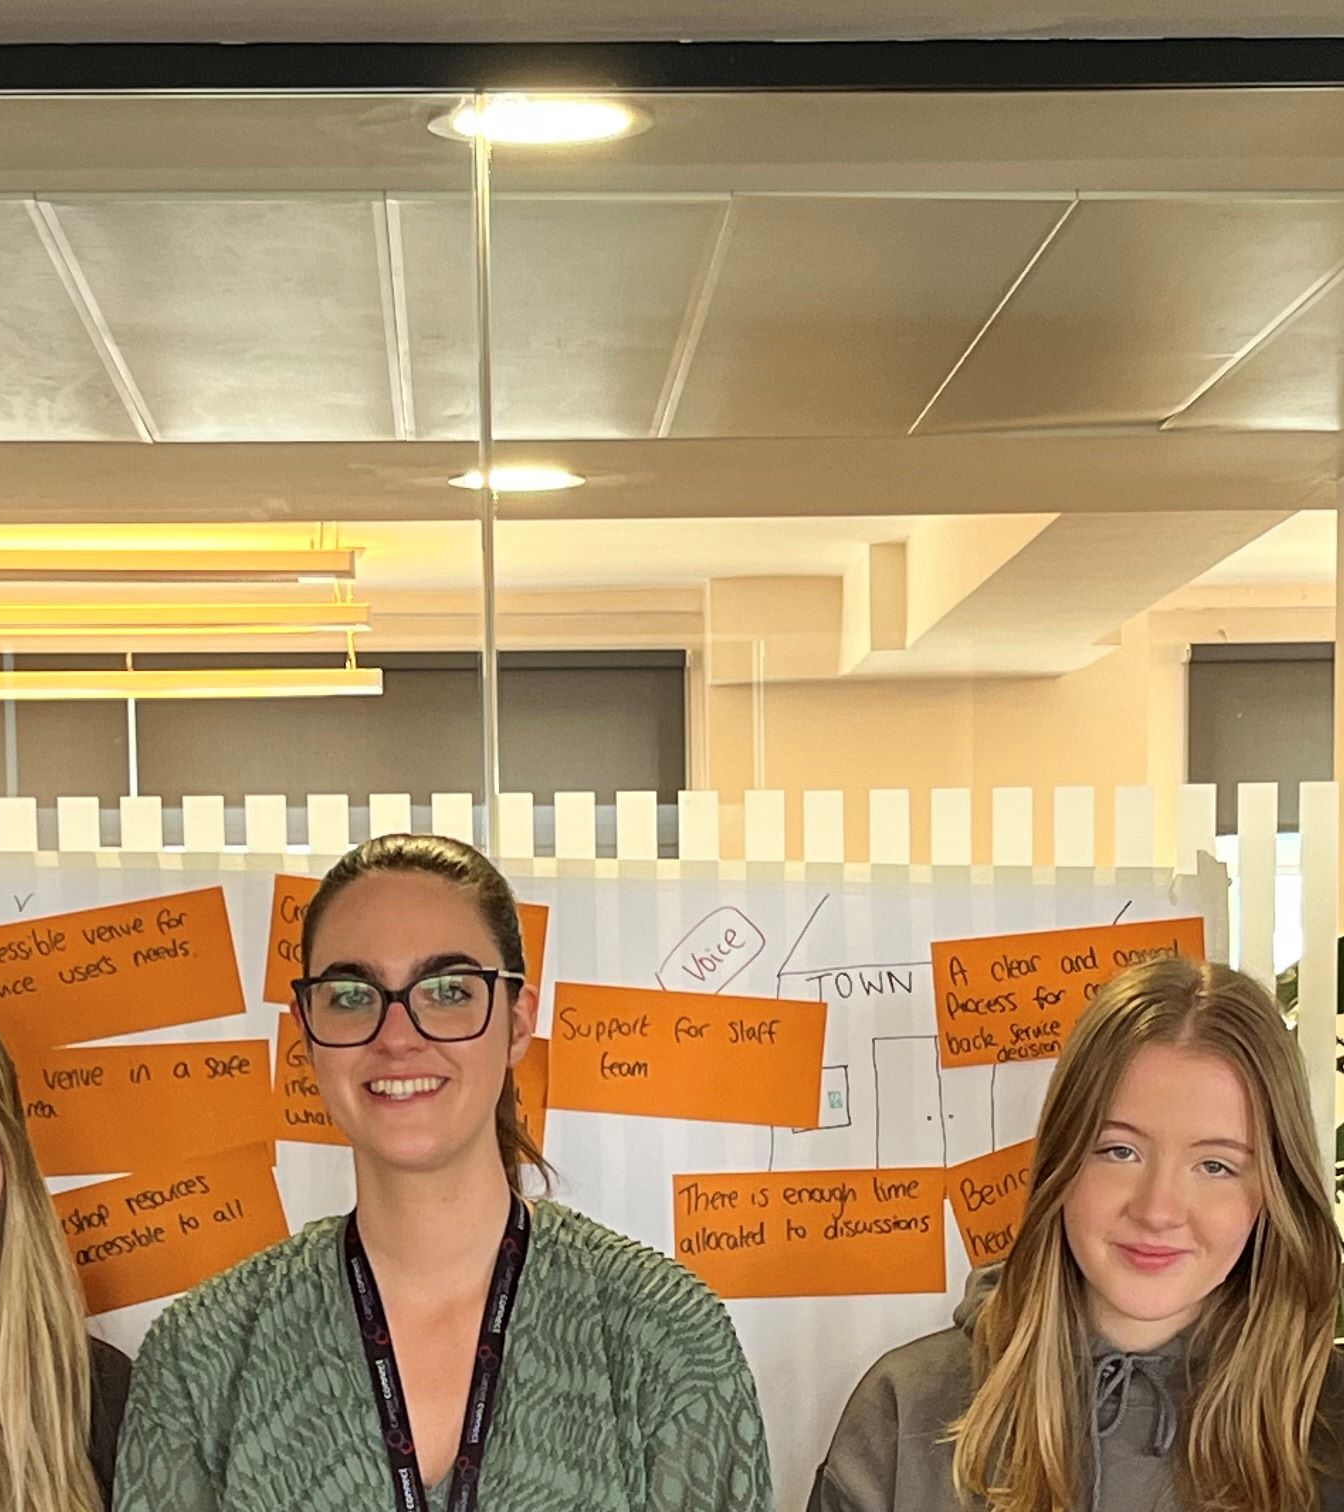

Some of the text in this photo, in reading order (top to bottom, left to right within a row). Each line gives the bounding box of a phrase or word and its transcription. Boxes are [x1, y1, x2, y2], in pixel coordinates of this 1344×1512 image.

[82, 917, 144, 945] venue
[156, 908, 188, 935] for
[682, 928, 746, 982] Voice
[949, 956, 968, 987] A
[991, 954, 1041, 982] clear
[1061, 946, 1098, 974] and
[806, 970, 913, 1002] TOWN
[1034, 986, 1066, 1010] for
[560, 1007, 651, 1041] Support
[674, 1016, 710, 1043] for
[946, 1027, 998, 1056] back
[43, 1055, 251, 1090] venue in a safe
[601, 1052, 648, 1080] team
[27, 1101, 58, 1119] rea
[678, 1183, 738, 1216] There
[751, 1187, 769, 1208] is
[782, 1183, 856, 1219] enough
[76, 1199, 244, 1266] accessible to all
[679, 1213, 931, 1256] allocated to discussions
